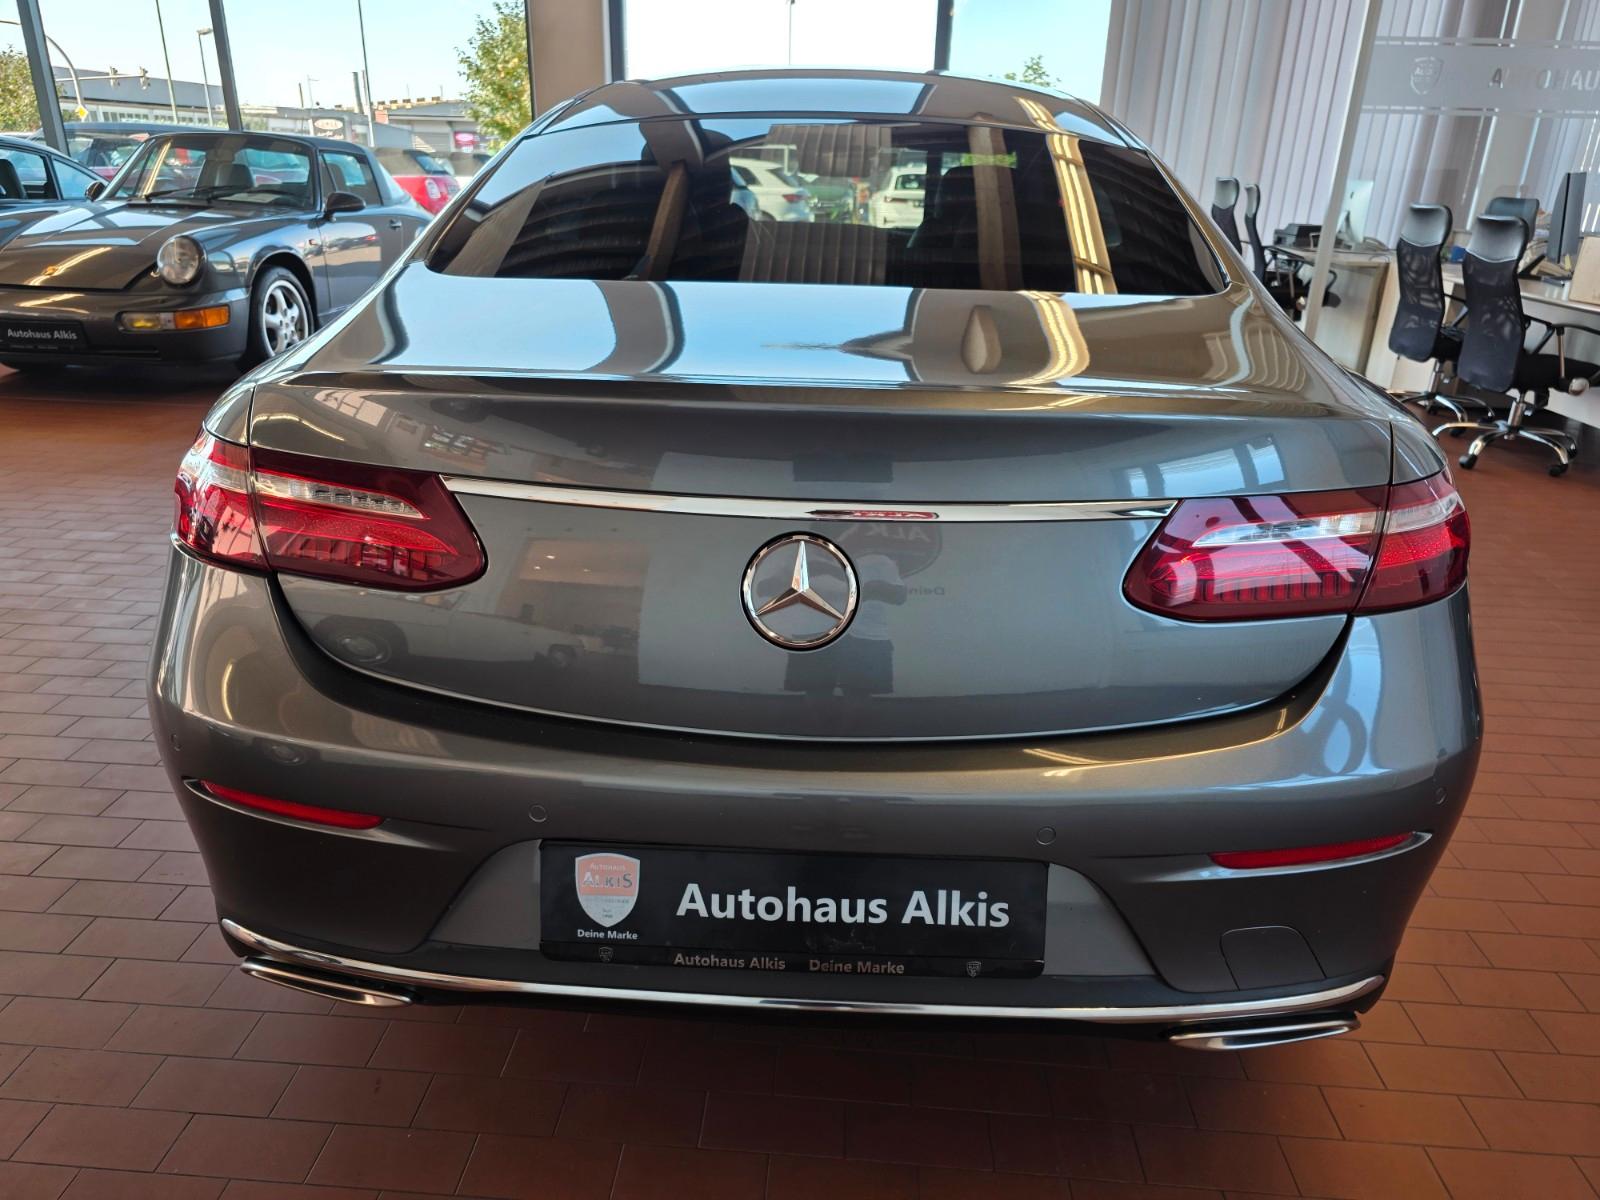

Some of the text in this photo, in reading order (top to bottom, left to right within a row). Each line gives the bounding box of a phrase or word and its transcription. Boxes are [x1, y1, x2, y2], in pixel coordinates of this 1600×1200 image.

[7, 328, 78, 340] Autohaus Alkis
[676, 882, 1010, 928] Autohaus Alkis
[577, 928, 639, 941] Deine Marke
[674, 953, 787, 970] Autohaus Alkis
[809, 959, 905, 975] Deine Marke
